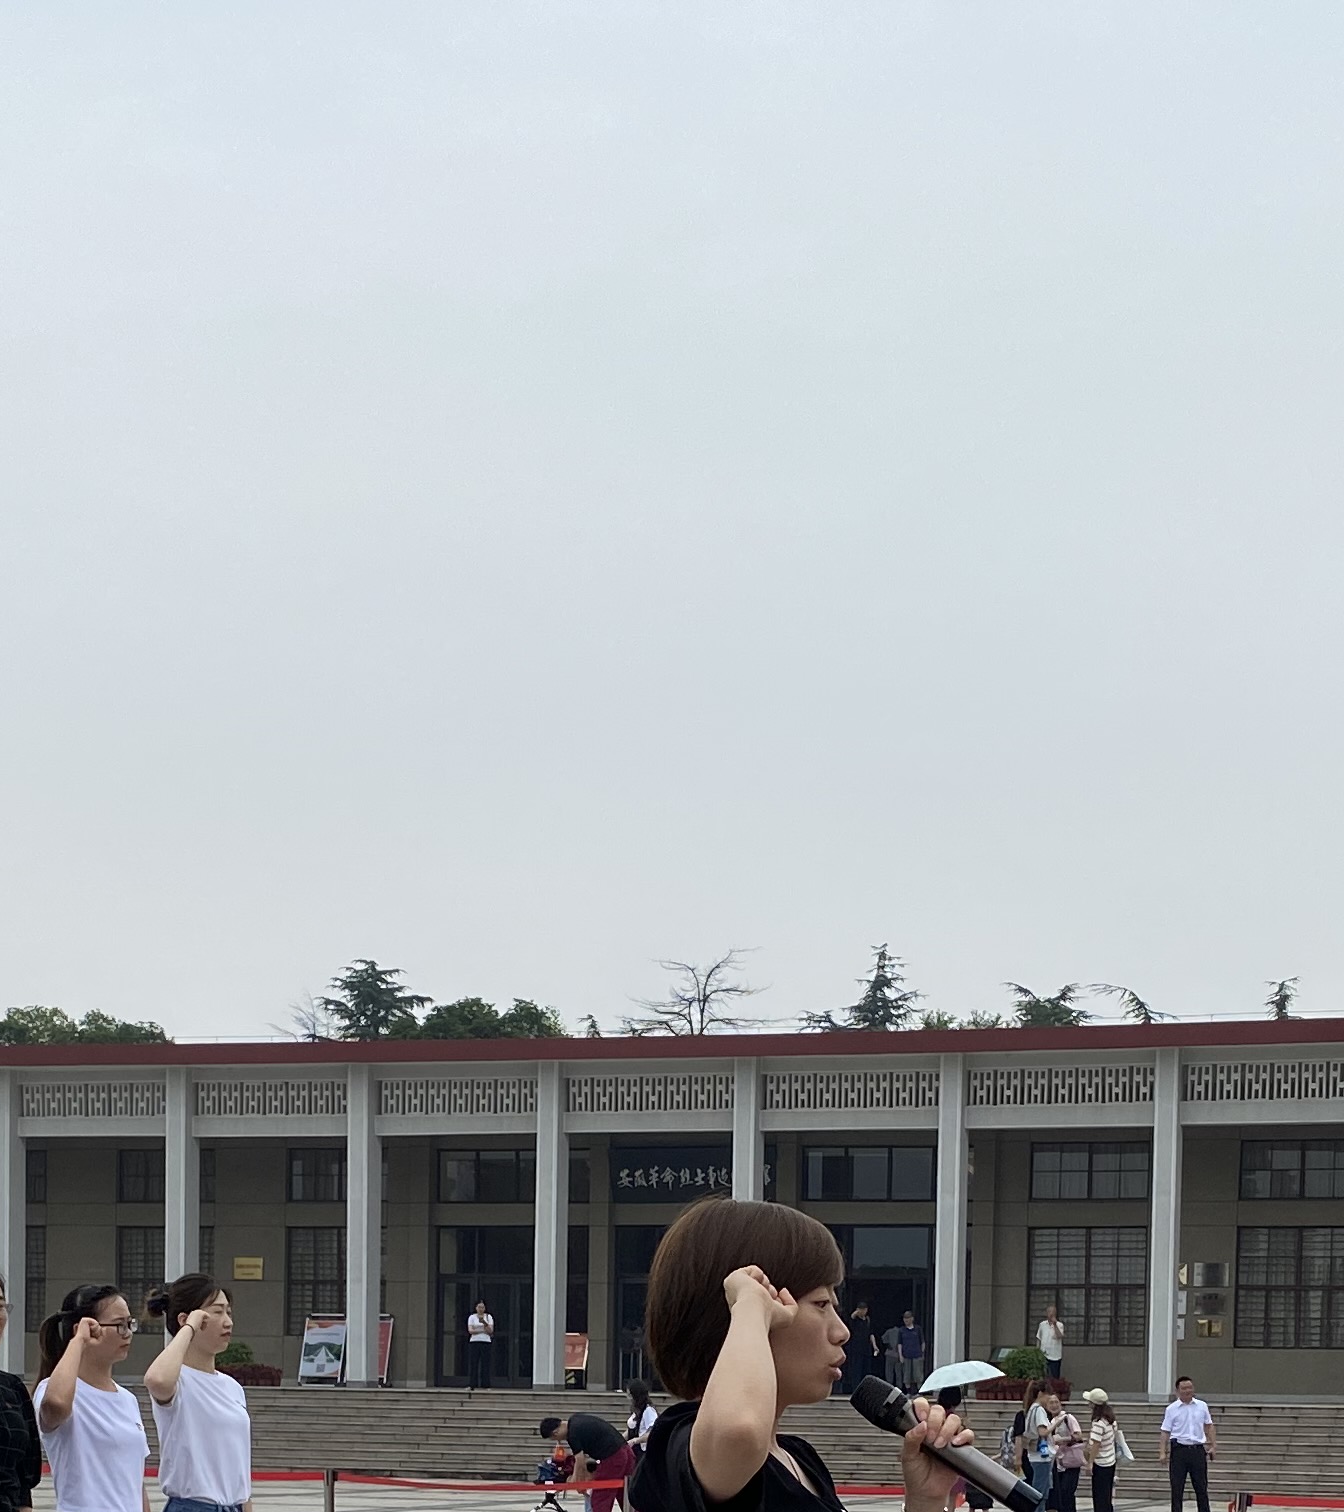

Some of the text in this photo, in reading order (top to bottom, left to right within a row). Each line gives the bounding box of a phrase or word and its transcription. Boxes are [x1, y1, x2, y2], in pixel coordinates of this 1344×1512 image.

[617, 1164, 771, 1191] 安徽革命烈士事迹
